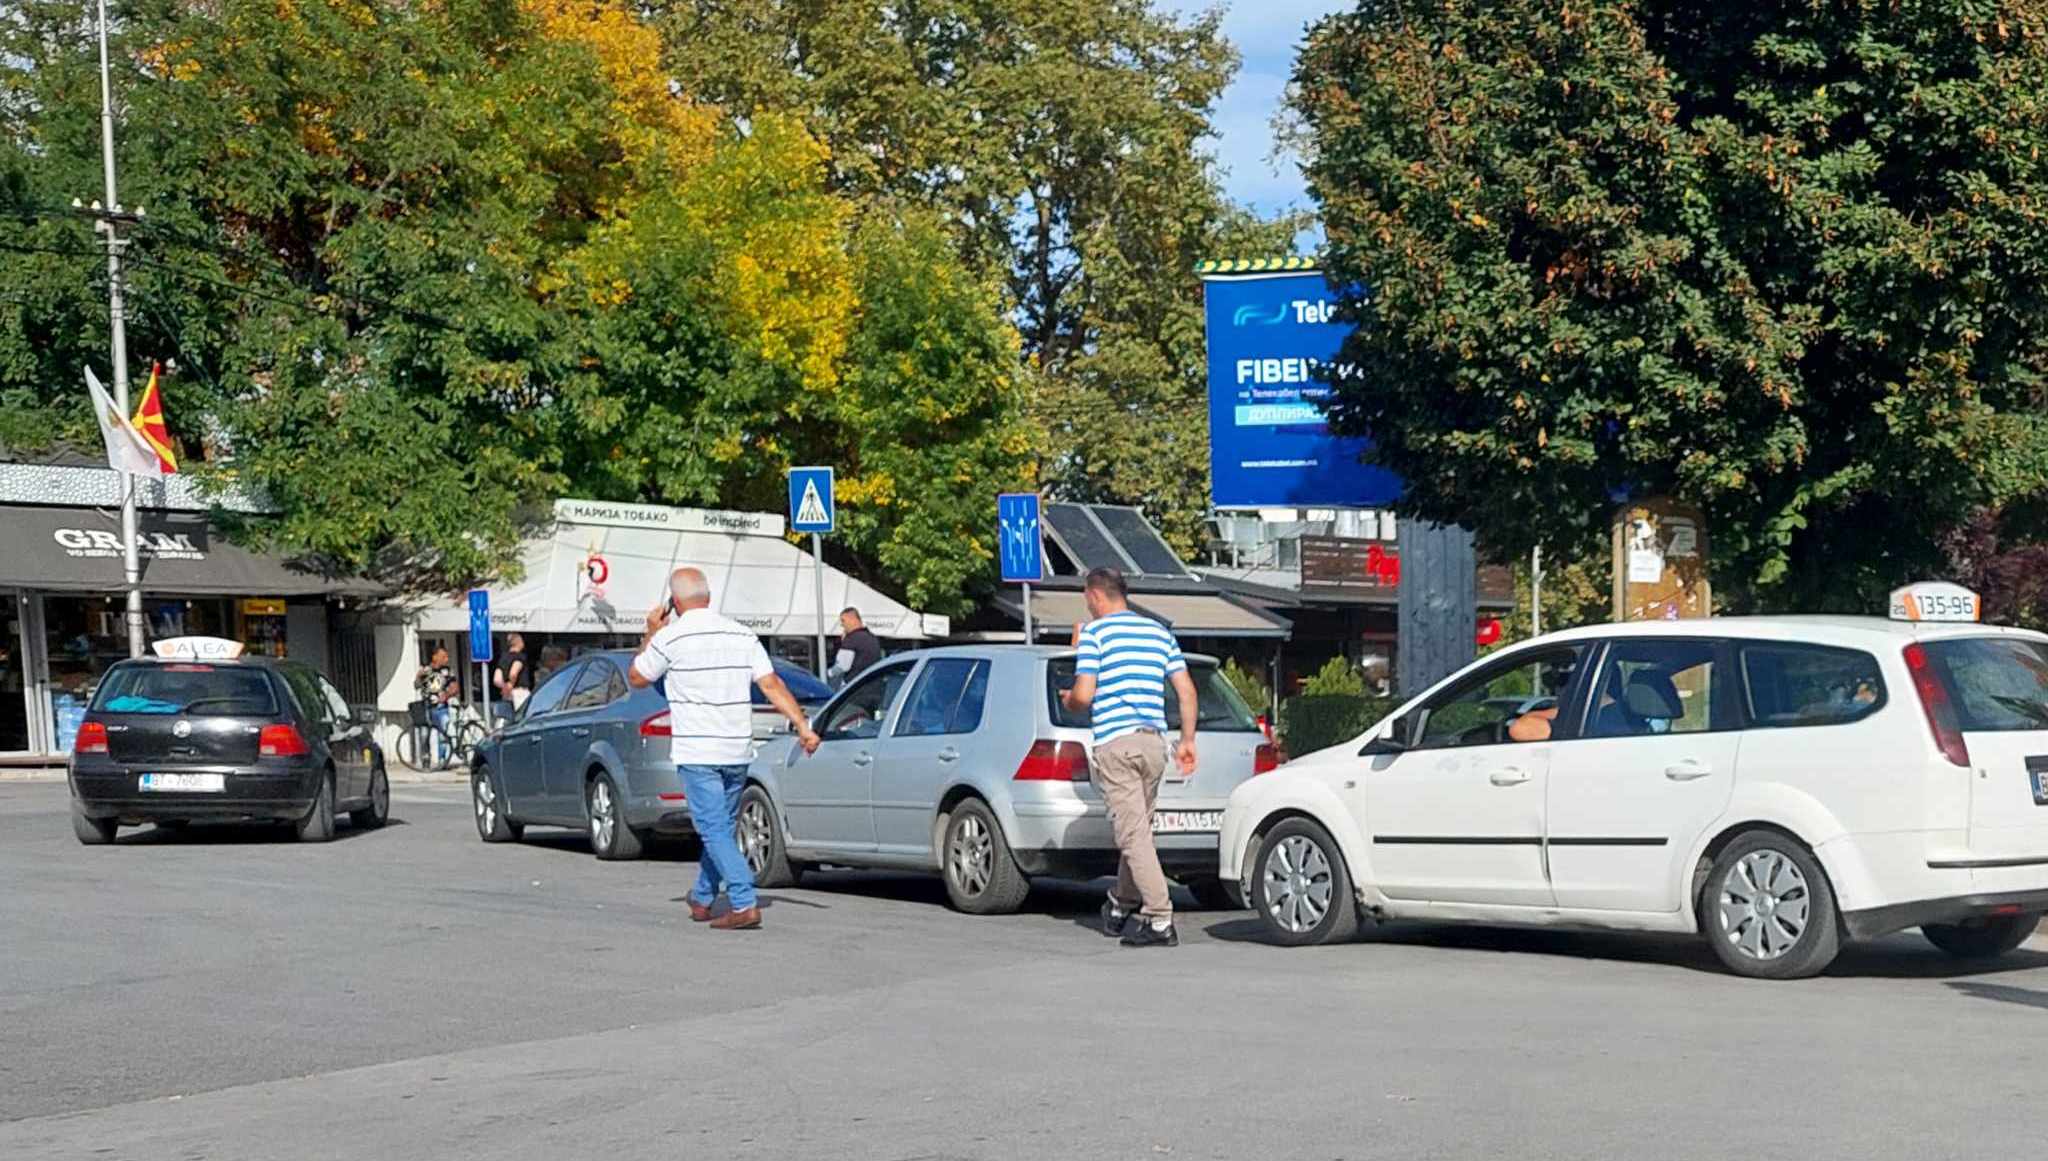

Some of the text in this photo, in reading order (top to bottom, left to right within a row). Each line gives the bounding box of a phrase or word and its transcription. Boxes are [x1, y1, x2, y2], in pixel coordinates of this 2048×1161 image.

[574, 506, 669, 522] МАРИЈА ТОБАКО
[719, 514, 761, 529] inspired
[54, 528, 199, 551] GRAM
[1917, 595, 1974, 615] 135-96
[492, 611, 528, 626] nspired
[176, 642, 228, 654] ALEA
